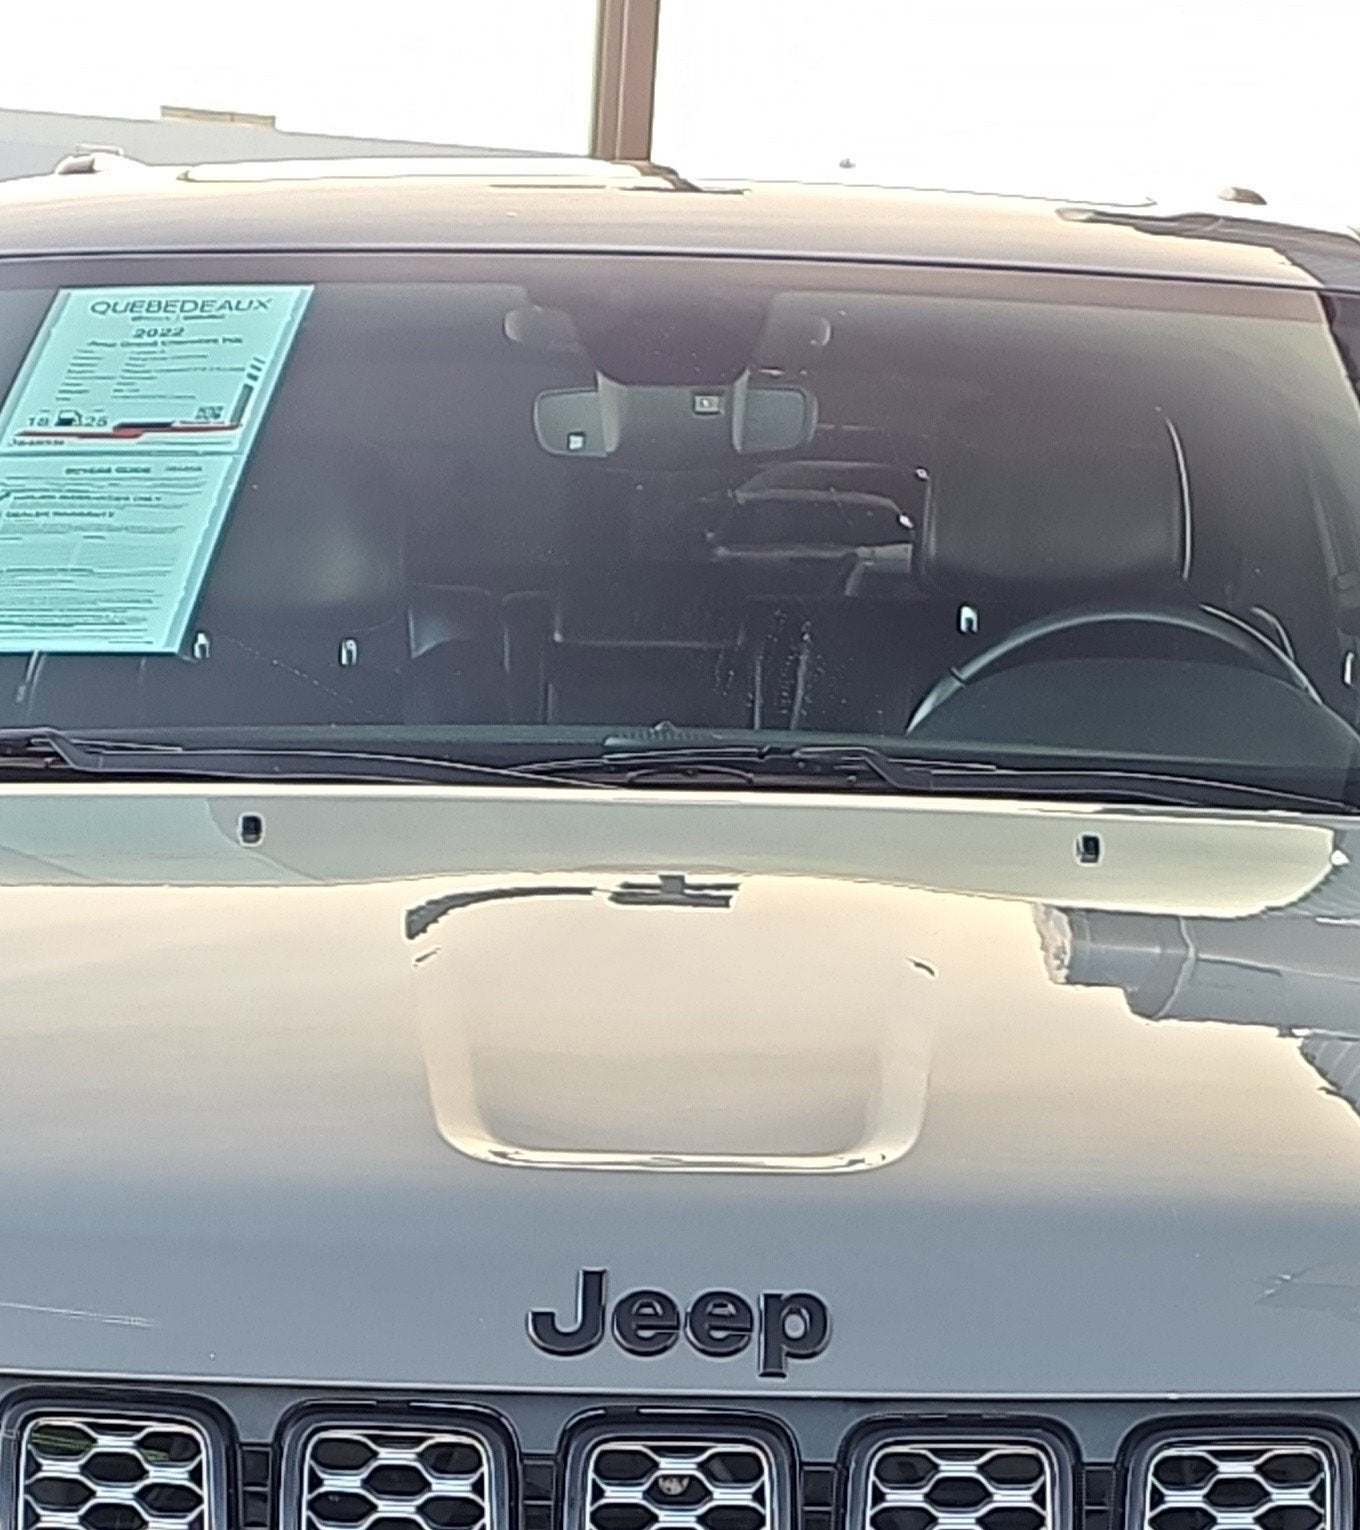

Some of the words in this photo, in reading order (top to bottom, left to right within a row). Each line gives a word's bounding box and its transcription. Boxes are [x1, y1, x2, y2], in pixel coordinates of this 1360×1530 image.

[90, 298, 272, 315] QUEBEDEAUX
[133, 326, 185, 339] 2022
[526, 1266, 832, 1379] Jeep
